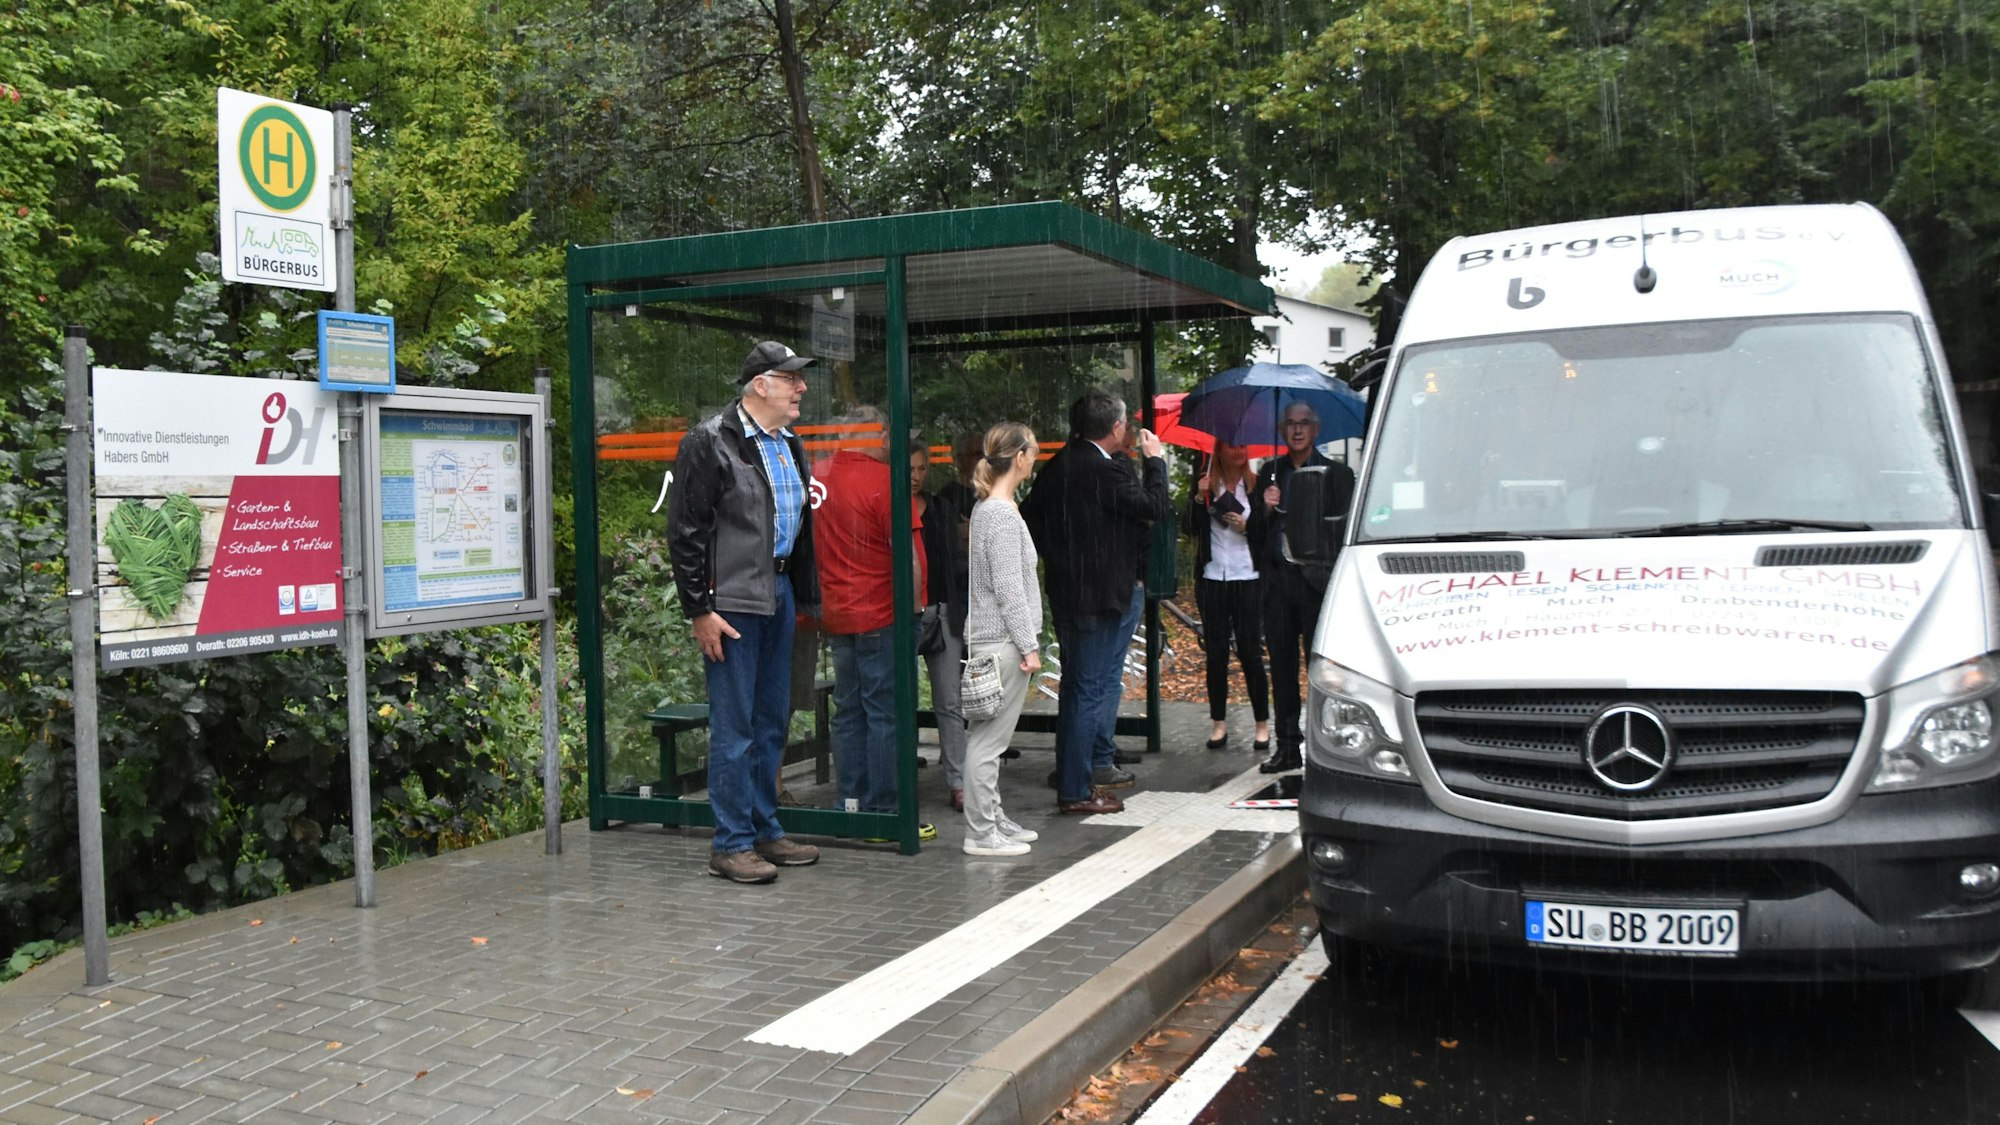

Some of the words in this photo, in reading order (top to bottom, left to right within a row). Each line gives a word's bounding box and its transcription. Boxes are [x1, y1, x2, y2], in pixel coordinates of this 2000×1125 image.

[263, 126, 294, 189] H
[1457, 226, 1787, 271] Bürgerbus
[244, 255, 318, 278] BÜRGERBUS
[1720, 272, 1779, 284] MUCH
[422, 420, 474, 431] Schwimmbad
[103, 430, 153, 443] Innovative
[155, 431, 230, 447] Dienstleistungen
[104, 451, 138, 463] Habers
[141, 451, 169, 463] GmbH
[237, 500, 280, 514] Garten-
[283, 500, 292, 512] &
[233, 515, 319, 531] Landschaftsbau
[229, 541, 278, 554] Straßen-
[281, 540, 289, 551] &
[293, 537, 334, 550] Tiefbau
[223, 565, 263, 578] Service
[1376, 571, 1551, 605] MICHAEL
[1569, 566, 1757, 583] KLEMENT
[1779, 567, 1921, 596] GMBH
[1380, 591, 1489, 615] SCHREIBEN
[1508, 586, 1567, 598] LESEN
[1586, 582, 1699, 593] SCHENKEN
[1720, 582, 1801, 595] LERNEN
[1823, 589, 1910, 607] SPIELEN
[1384, 604, 1481, 626] Overath
[1546, 595, 1615, 607] Much
[1681, 594, 1905, 621] Drabenderhöhe
[1438, 618, 1487, 631] Much
[110, 650, 130, 661] Köln:
[131, 648, 150, 659] 0221
[152, 643, 189, 657] 98609600
[196, 640, 226, 652] Overath:
[227, 636, 248, 648] 02206
[249, 634, 274, 646] 905430
[281, 628, 338, 642] www.idh-koeln.de
[1395, 620, 1889, 654] www.klement-schreibwaren.de
[1547, 908, 1584, 940] SU
[1609, 911, 1647, 943] BB
[1657, 914, 1734, 945] 2009
